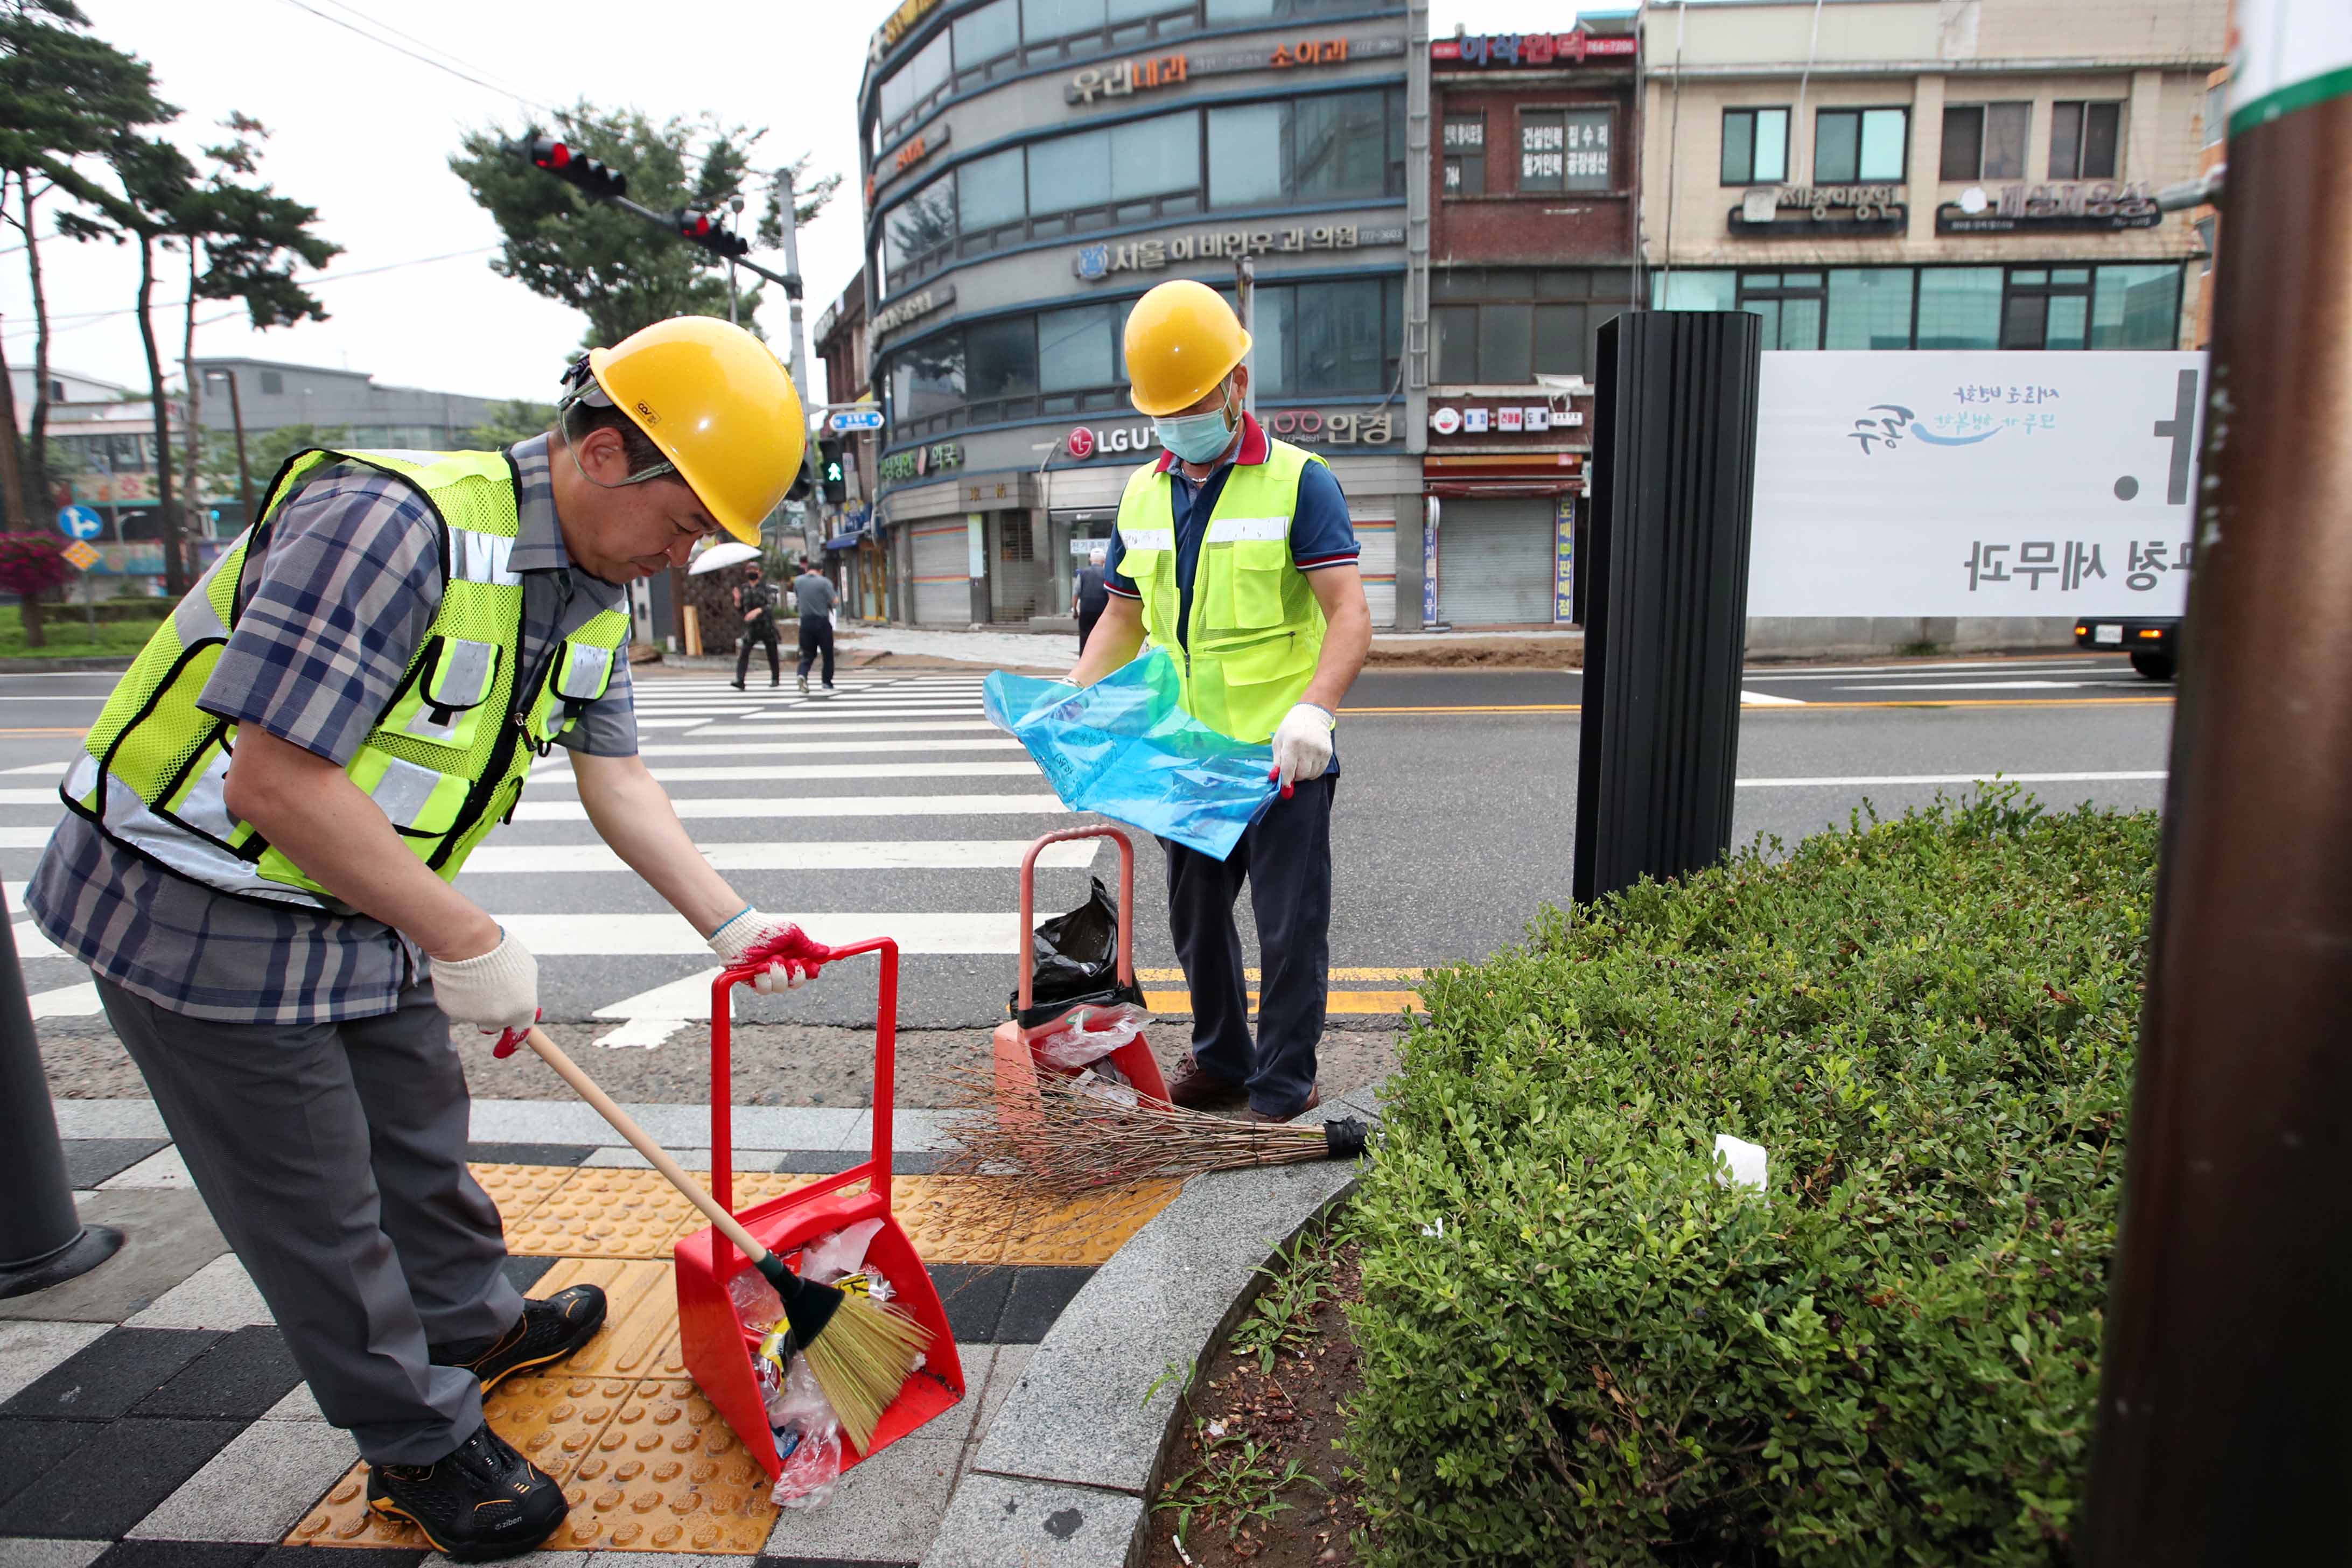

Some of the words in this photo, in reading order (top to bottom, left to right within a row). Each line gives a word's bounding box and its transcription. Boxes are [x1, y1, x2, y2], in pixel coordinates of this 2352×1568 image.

[1073, 52, 1187, 103] 우리내과
[1326, 413, 1392, 444] 안경
[502, 1516, 522, 1528] ziben
